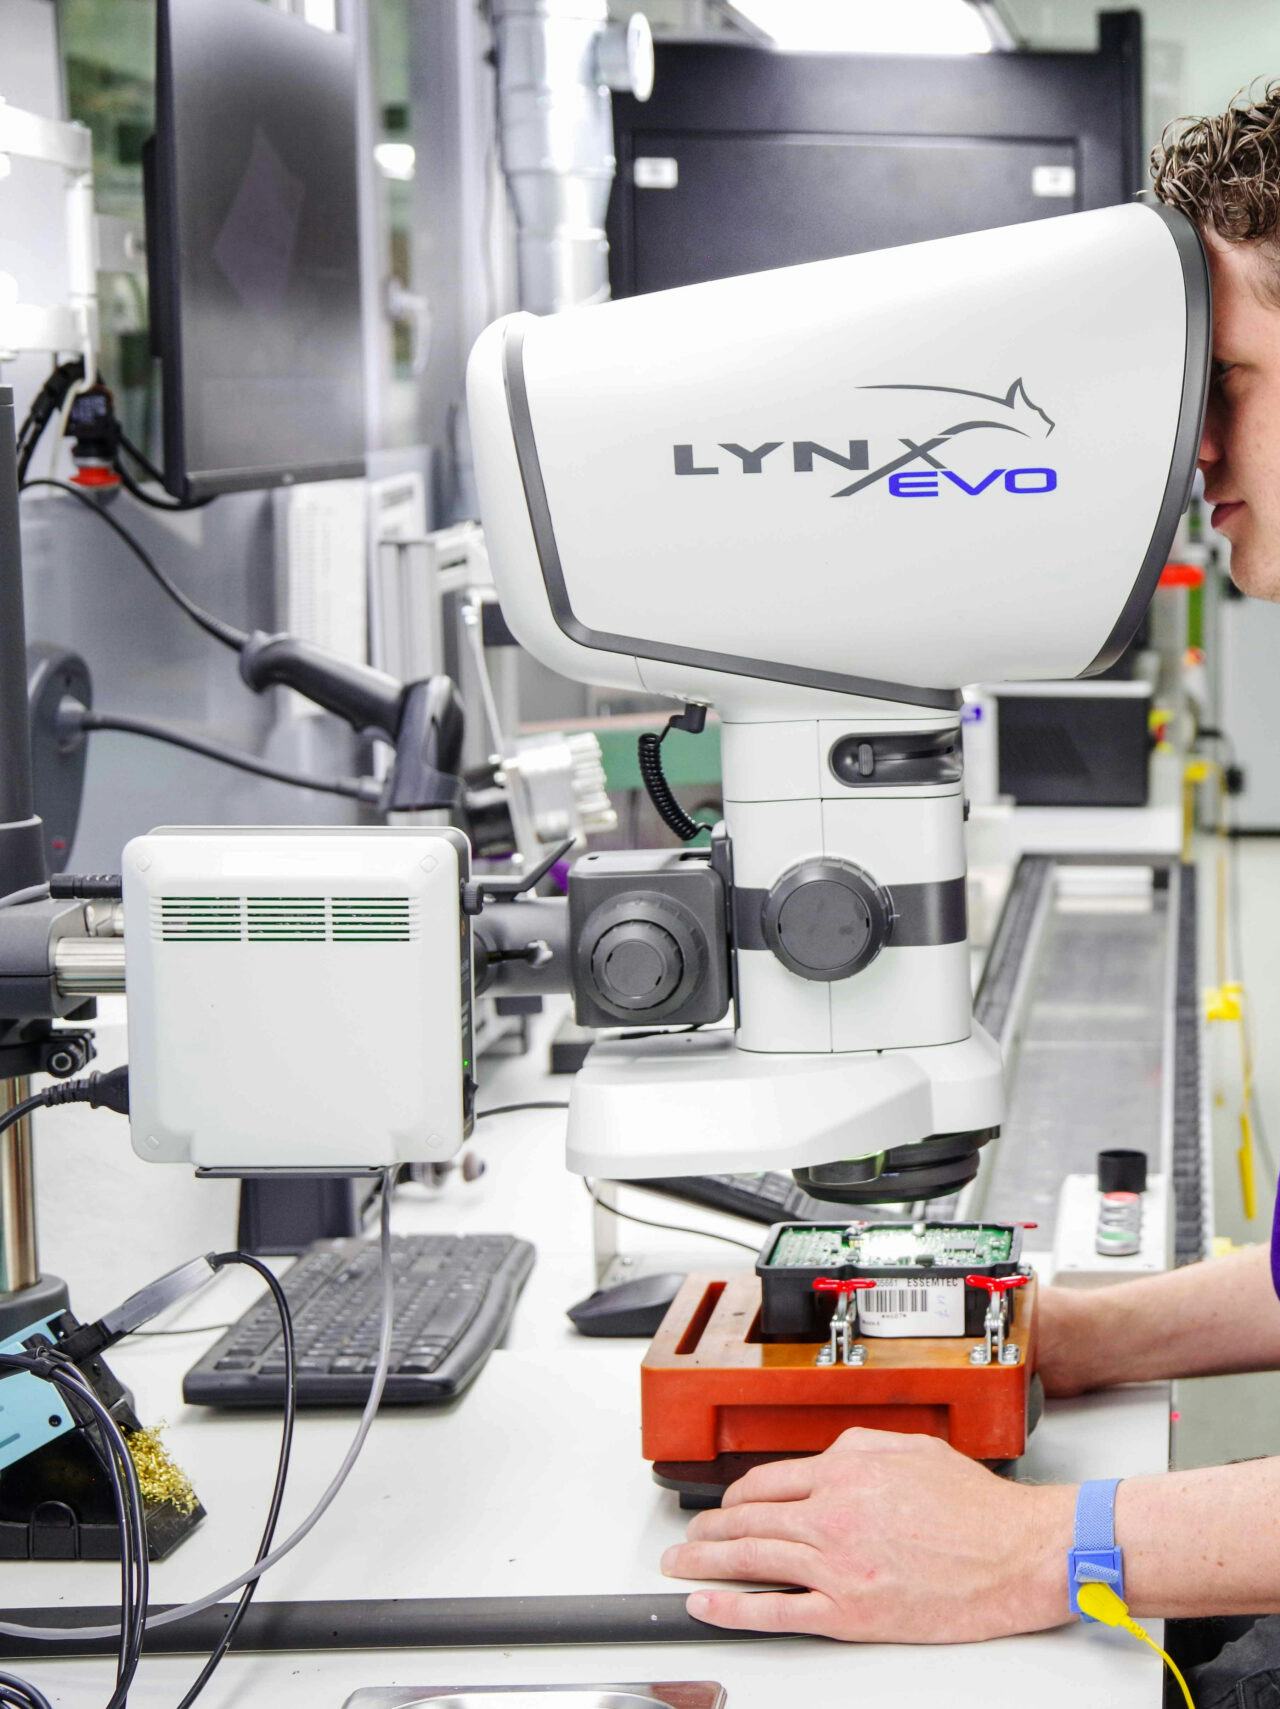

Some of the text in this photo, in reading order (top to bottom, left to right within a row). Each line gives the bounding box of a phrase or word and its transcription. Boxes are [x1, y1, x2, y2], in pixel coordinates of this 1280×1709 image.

[673, 438, 952, 498] LYNX
[888, 467, 1057, 498] EVO
[907, 1277, 958, 1288] ESSEMTEC
